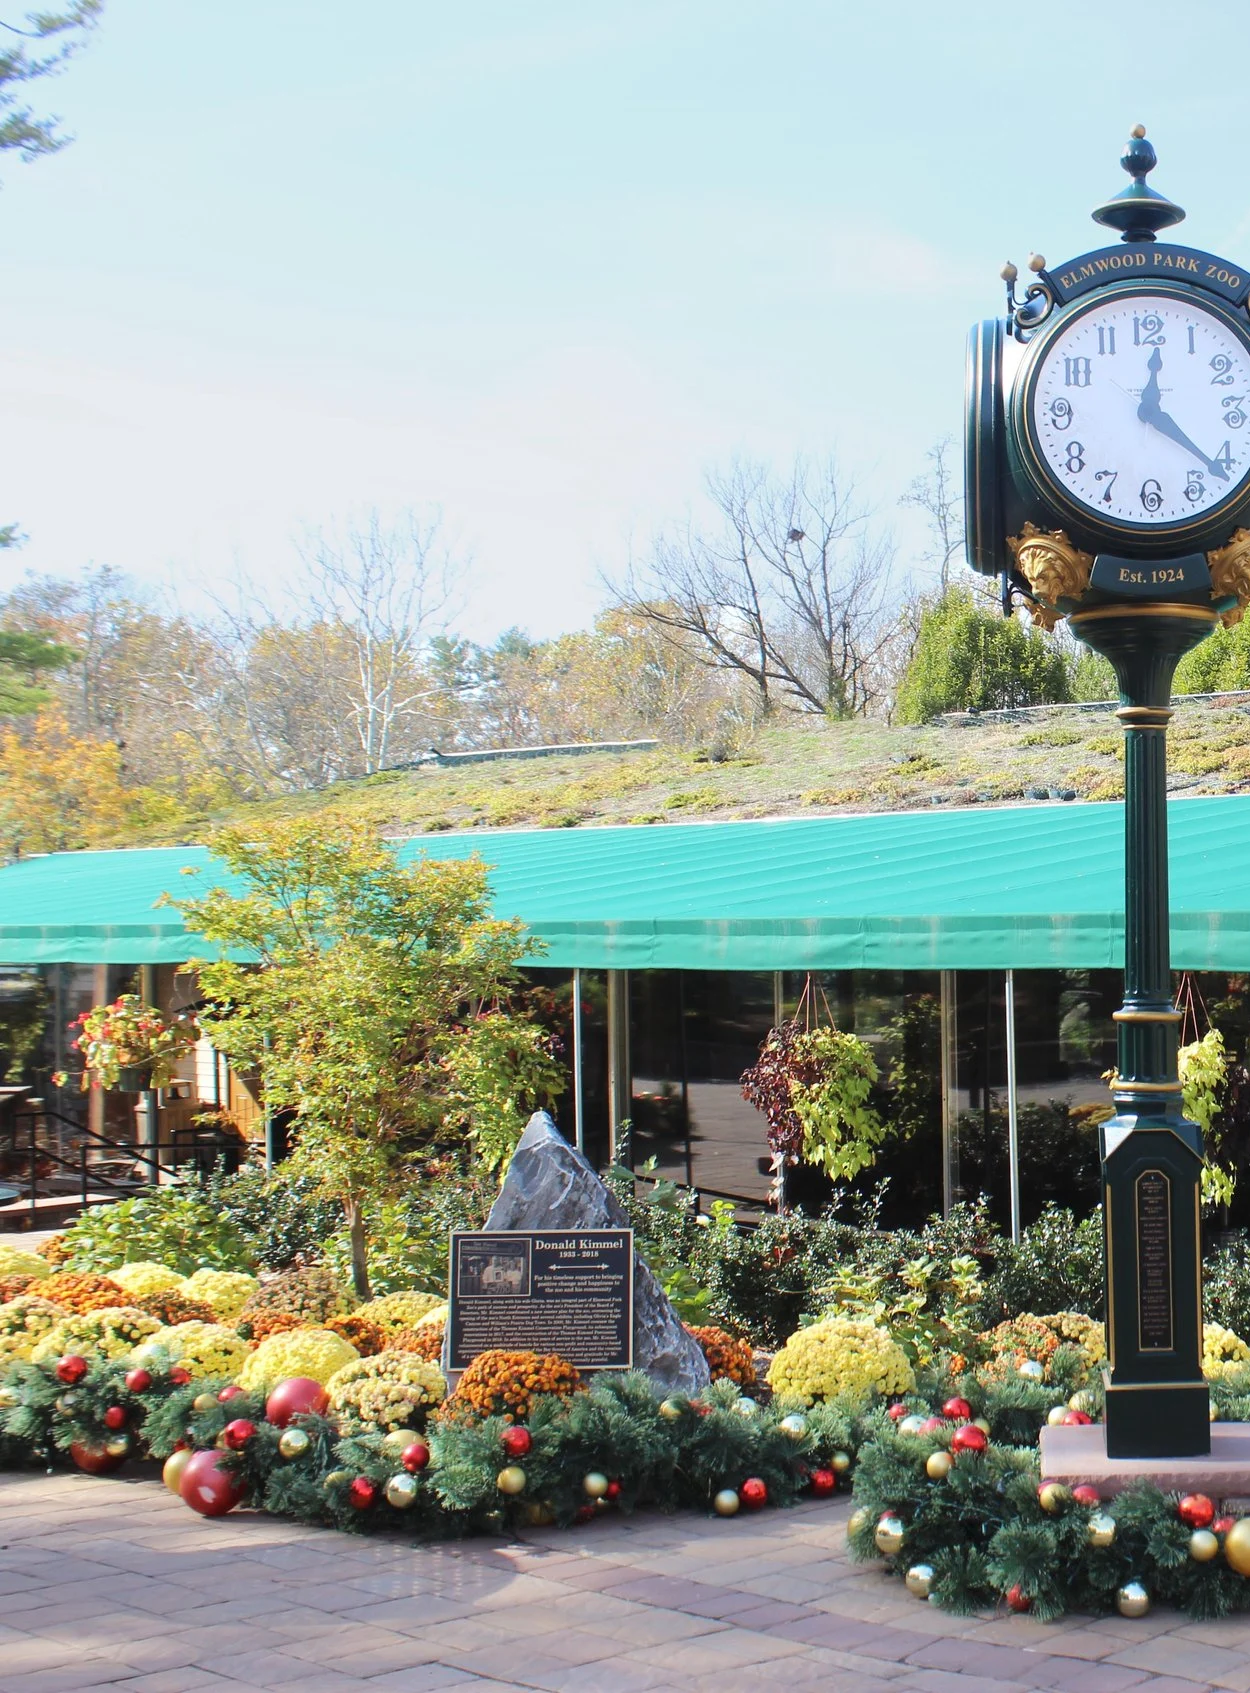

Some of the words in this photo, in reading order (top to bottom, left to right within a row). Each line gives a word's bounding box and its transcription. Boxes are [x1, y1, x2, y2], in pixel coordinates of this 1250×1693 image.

[1059, 252, 1146, 290] ELMWOOD
[1153, 252, 1201, 273] PARK
[1205, 263, 1241, 289] ZOO
[1097, 325, 1117, 356] 11
[1132, 314, 1166, 347] 12
[1187, 325, 1196, 356] 1
[1064, 356, 1092, 388] 10
[1208, 353, 1235, 386] 2
[1050, 397, 1075, 431] 9
[1220, 395, 1248, 430] 3
[1065, 440, 1086, 474] 8
[1213, 440, 1237, 471] 4
[1094, 469, 1118, 503] 7
[1139, 478, 1164, 513] 6
[1182, 469, 1207, 502] 5
[1119, 568, 1147, 584] Est.
[1151, 568, 1185, 584] 1924
[535, 1239, 576, 1250] Donald
[579, 1238, 623, 1249] Kimmel
[582, 1250, 599, 1258] 2018
